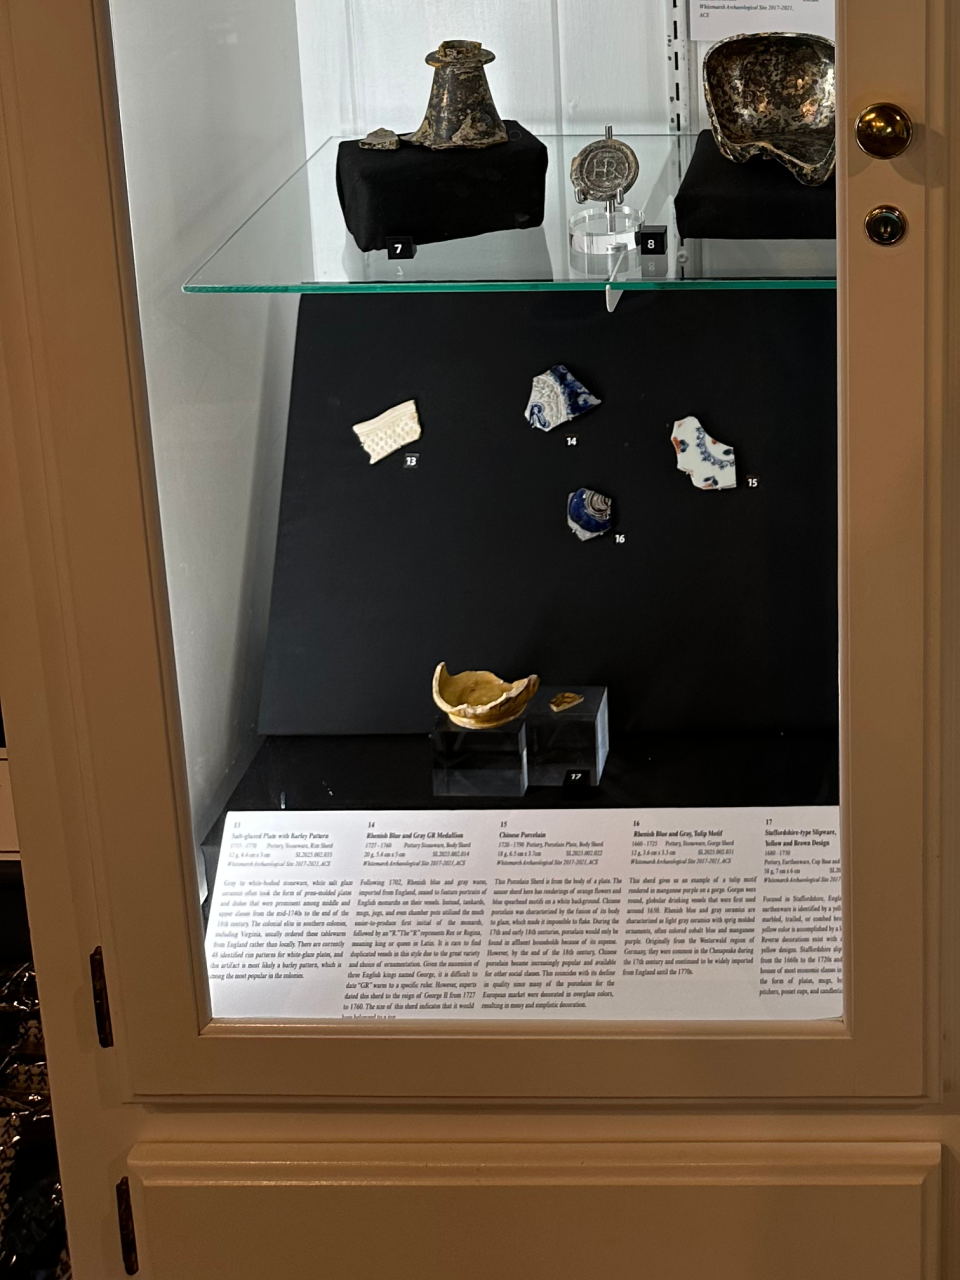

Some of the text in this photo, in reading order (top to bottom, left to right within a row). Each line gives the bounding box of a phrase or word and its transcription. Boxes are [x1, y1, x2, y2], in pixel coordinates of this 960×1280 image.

[647, 239, 655, 249] 8
[394, 244, 402, 254] 7
[566, 437, 577, 446] 14
[406, 456, 417, 466] 13
[748, 478, 758, 488] 15
[615, 534, 626, 544] 16
[290, 832, 307, 840] Barley
[412, 832, 425, 840] Gray
[694, 830, 707, 838] Tulip
[811, 839, 830, 847] Design
